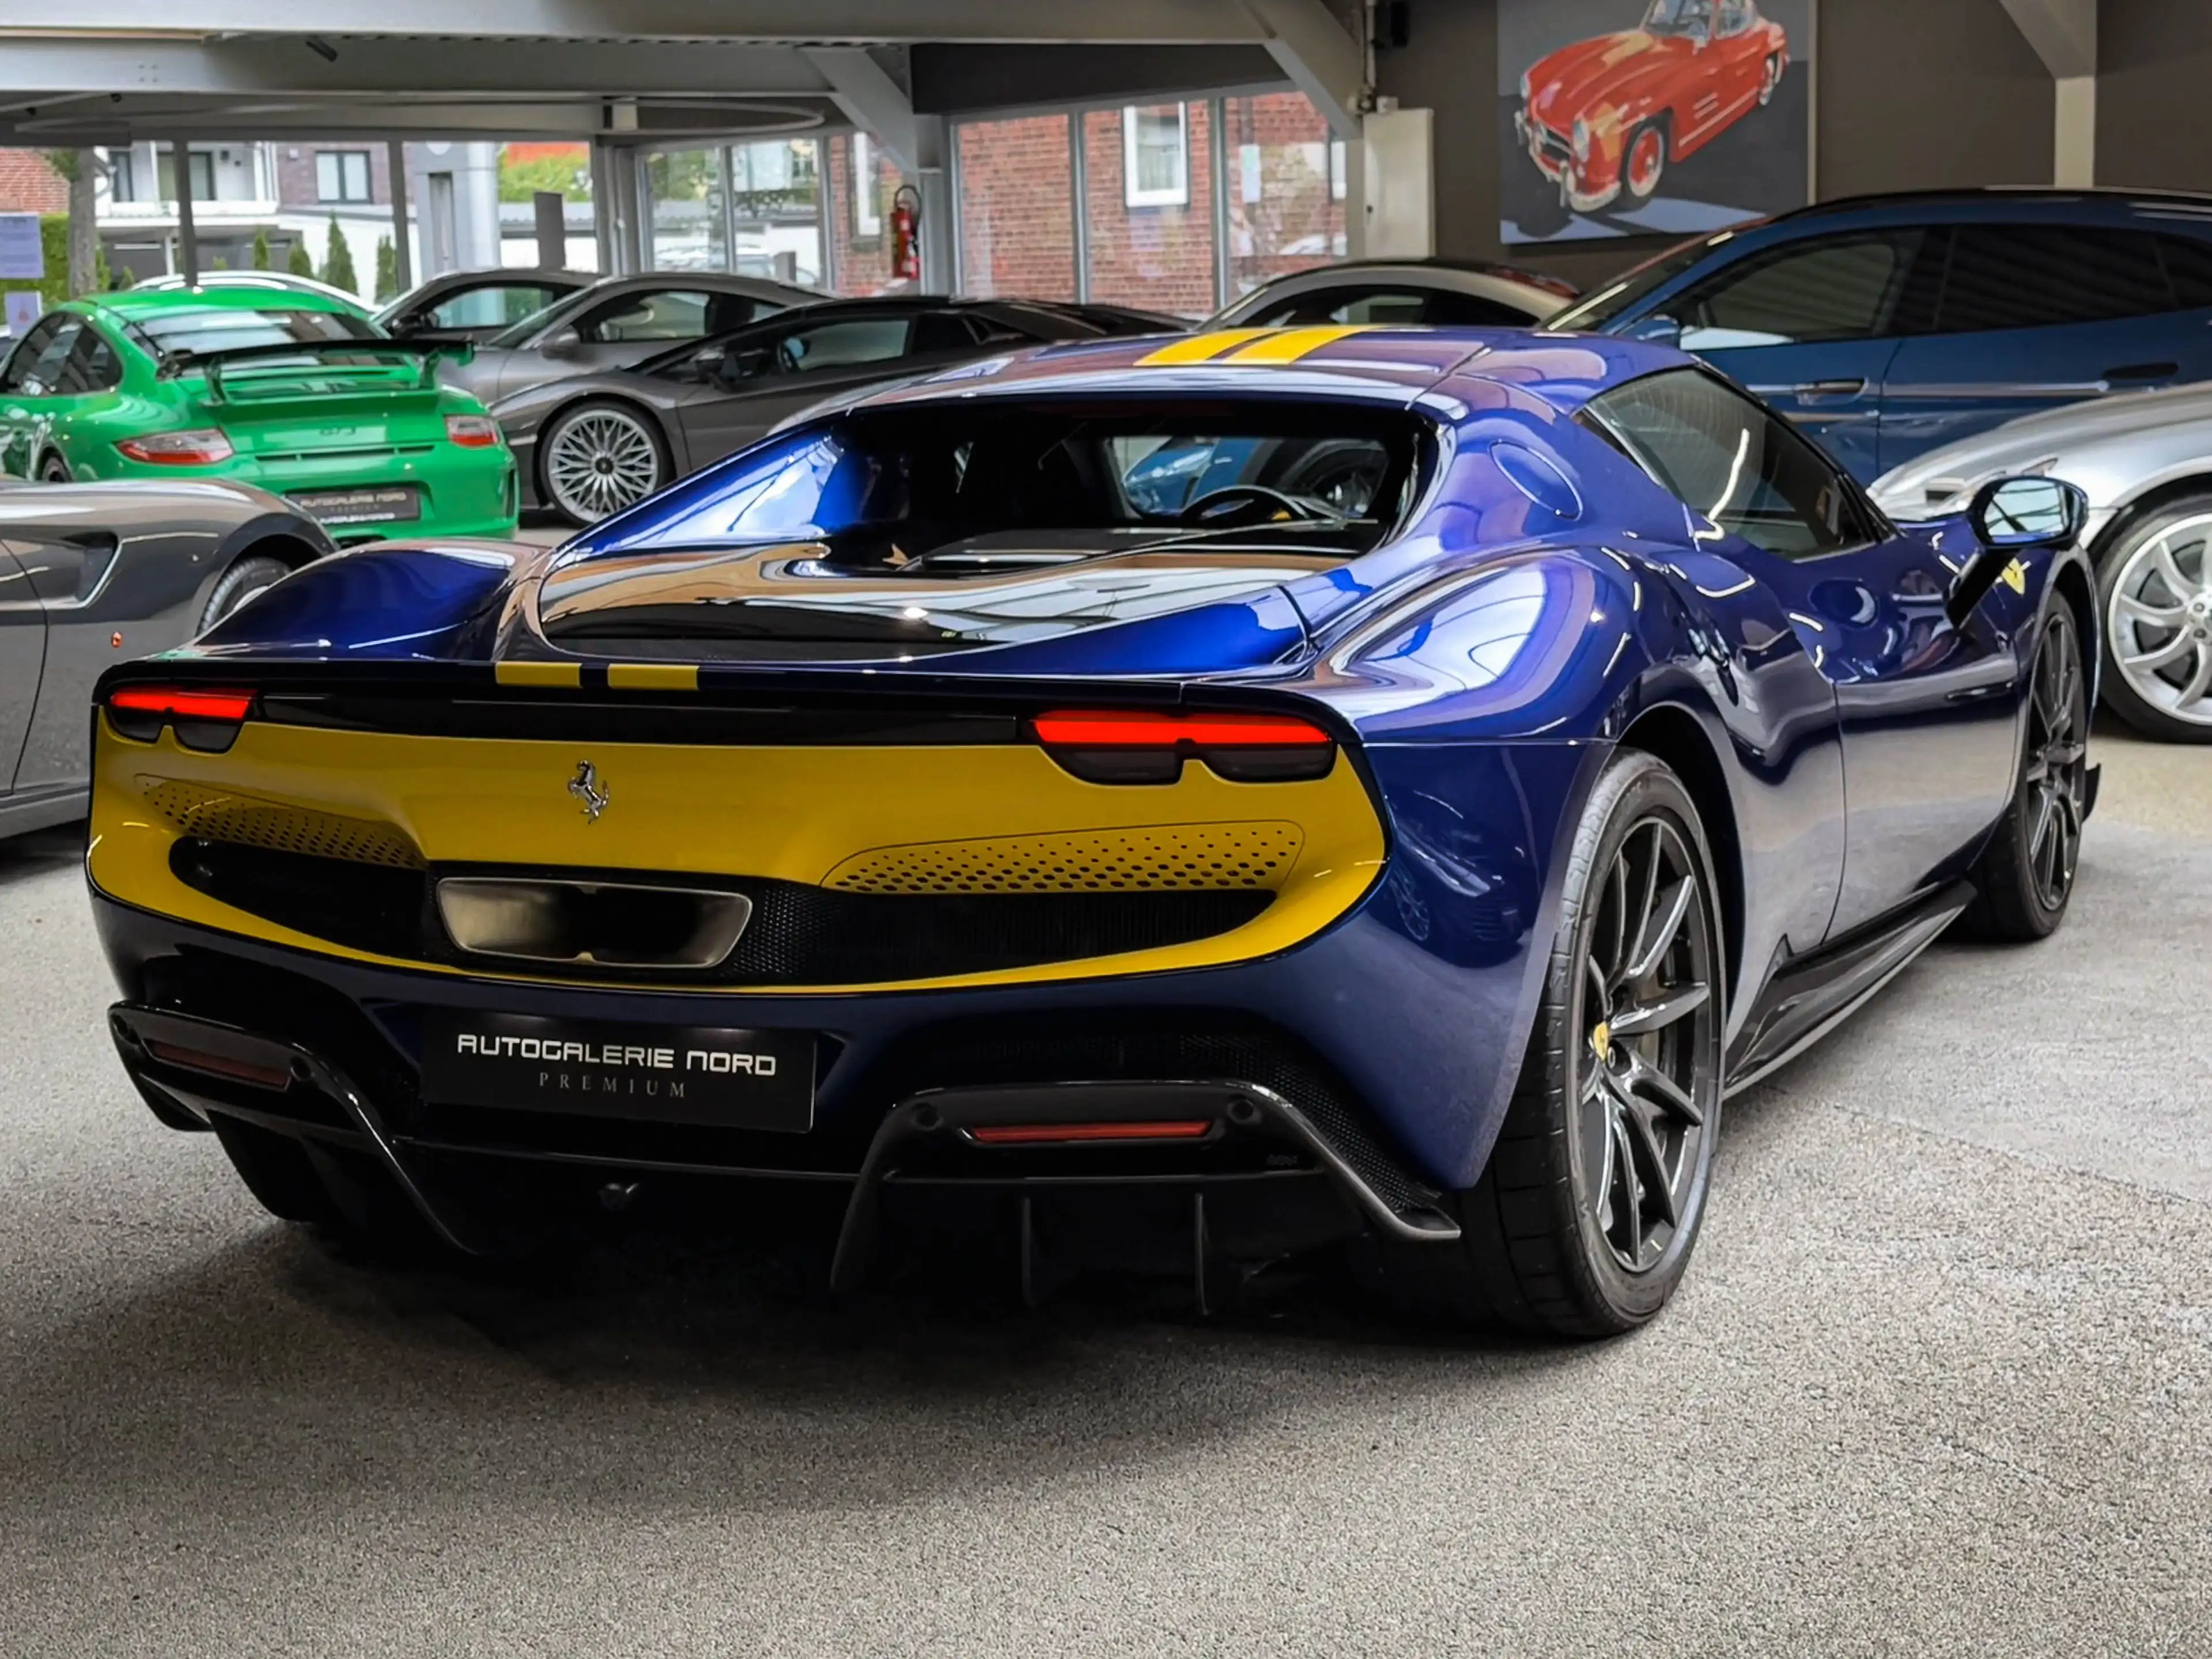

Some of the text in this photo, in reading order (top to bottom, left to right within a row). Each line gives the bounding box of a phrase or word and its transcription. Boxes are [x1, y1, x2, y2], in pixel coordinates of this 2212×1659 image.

[457, 1034, 776, 1076] AUTOGALERIE NORD
[538, 1072, 686, 1097] PREMIUM
